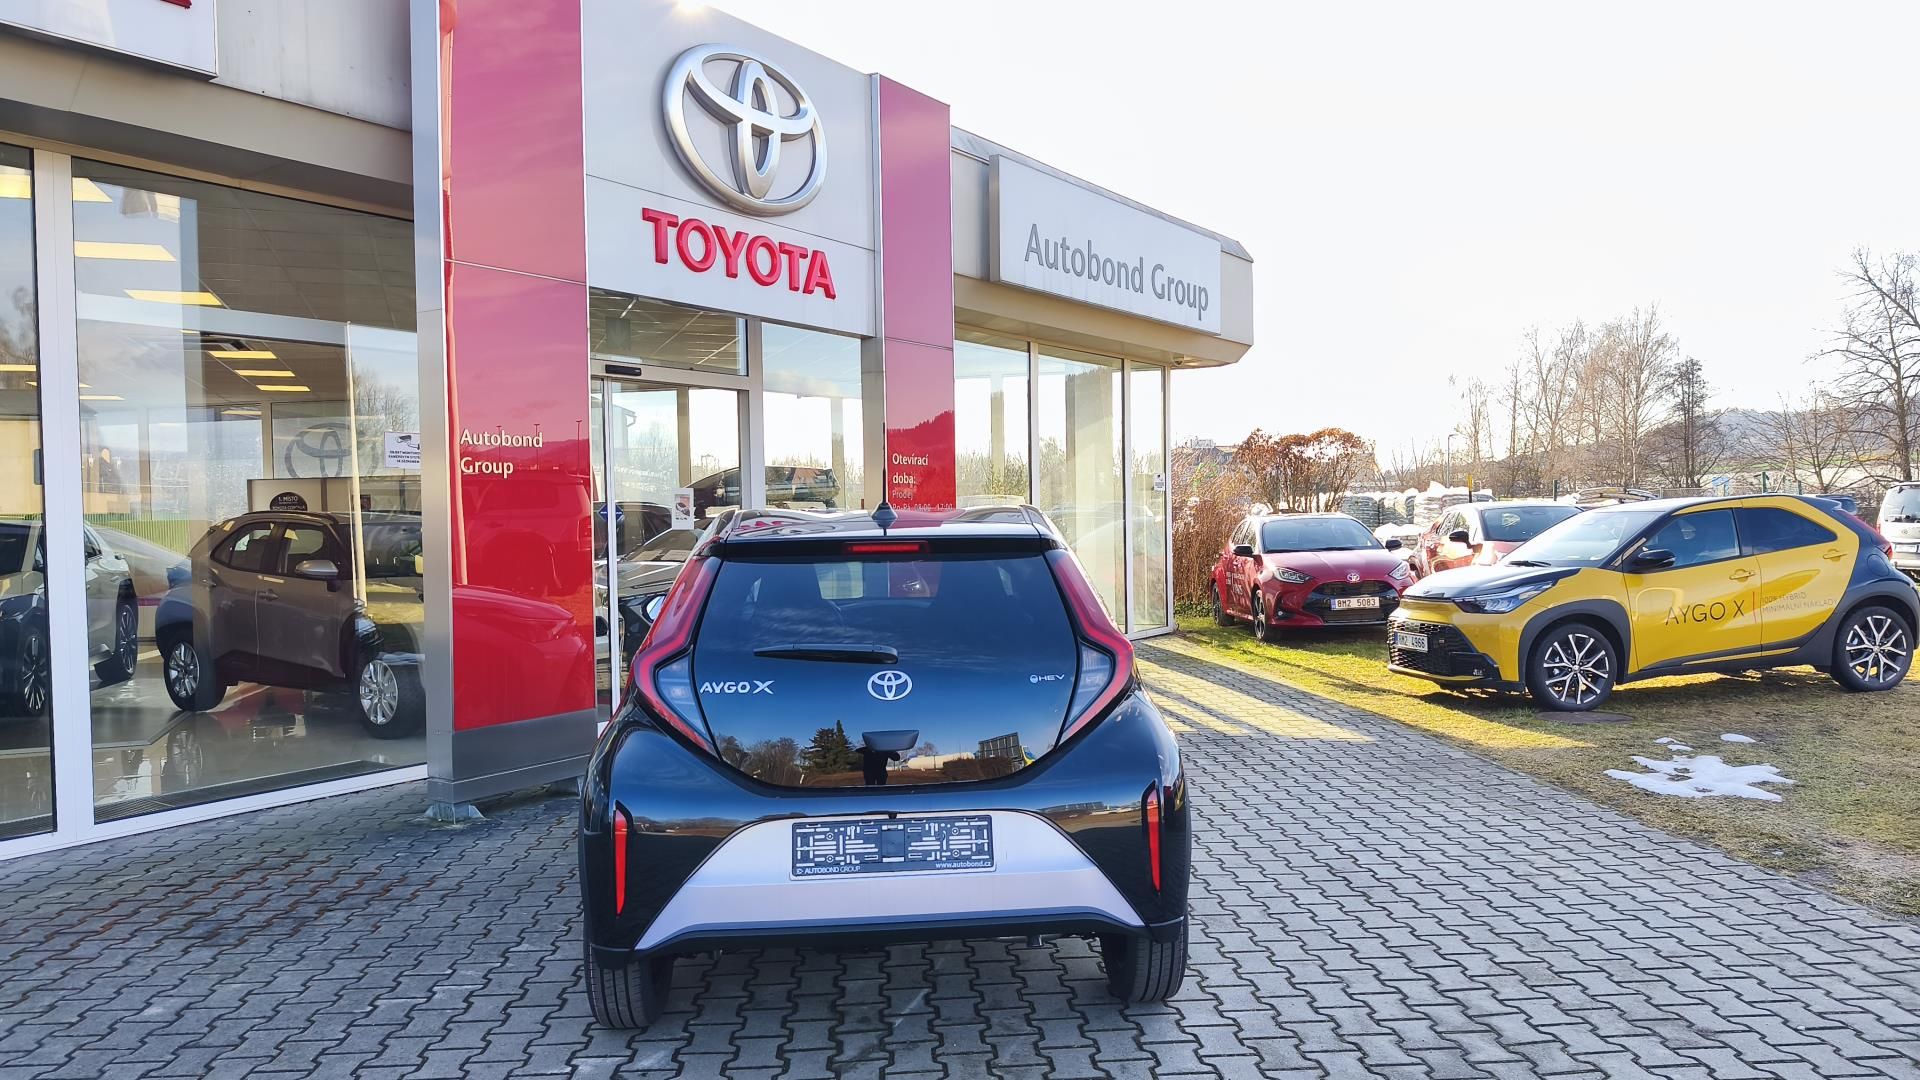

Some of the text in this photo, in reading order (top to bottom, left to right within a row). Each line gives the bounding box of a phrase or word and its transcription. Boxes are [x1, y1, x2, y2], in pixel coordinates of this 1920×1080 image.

[642, 207, 836, 300] TOYOTA
[1024, 223, 1209, 321] Autobond Group
[460, 429, 543, 448] Autobond
[460, 457, 514, 479] Group
[892, 453, 929, 466] Otevírací
[892, 472, 916, 484] doba:
[1356, 598, 1376, 607] 5083
[1665, 600, 1745, 626] AYGO X
[700, 680, 775, 695] AYGO X
[840, 865, 861, 873] GROUP
